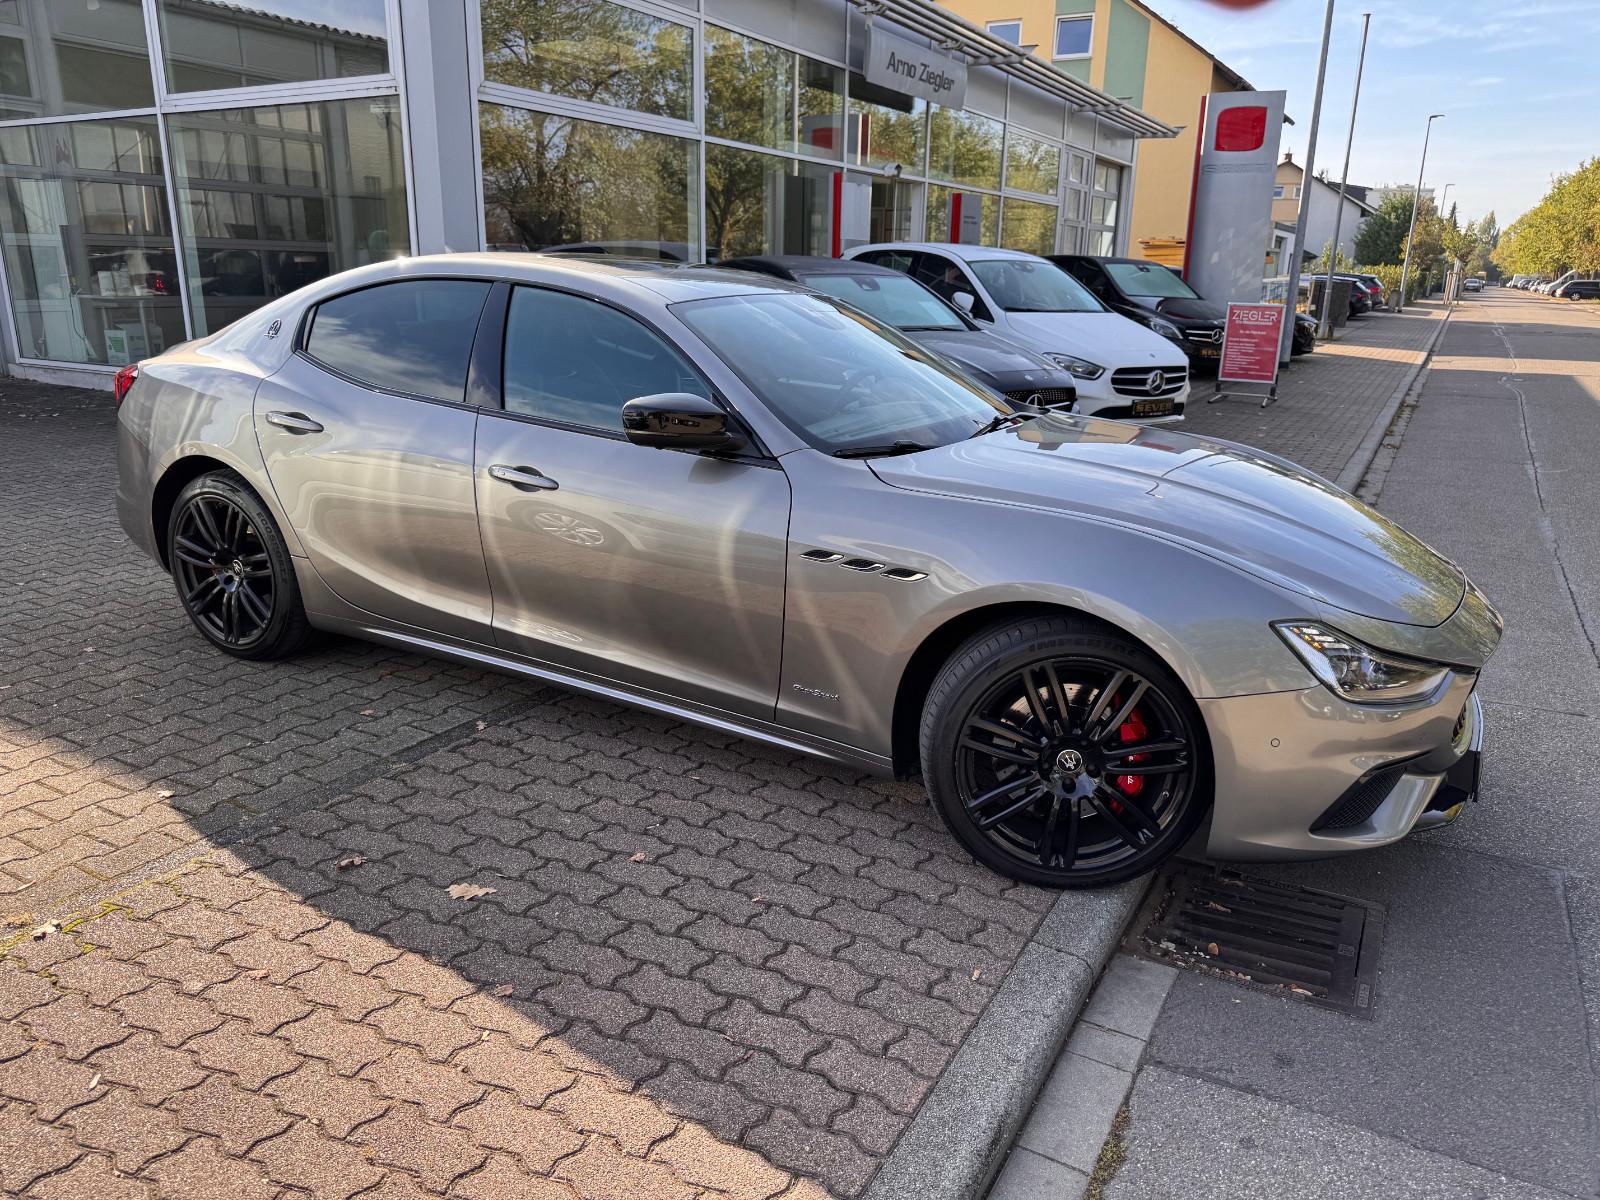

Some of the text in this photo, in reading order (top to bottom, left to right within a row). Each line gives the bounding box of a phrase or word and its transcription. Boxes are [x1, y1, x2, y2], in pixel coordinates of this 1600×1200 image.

[886, 51, 954, 92] Arno Ziegler
[1232, 309, 1278, 322] ZIEGLER
